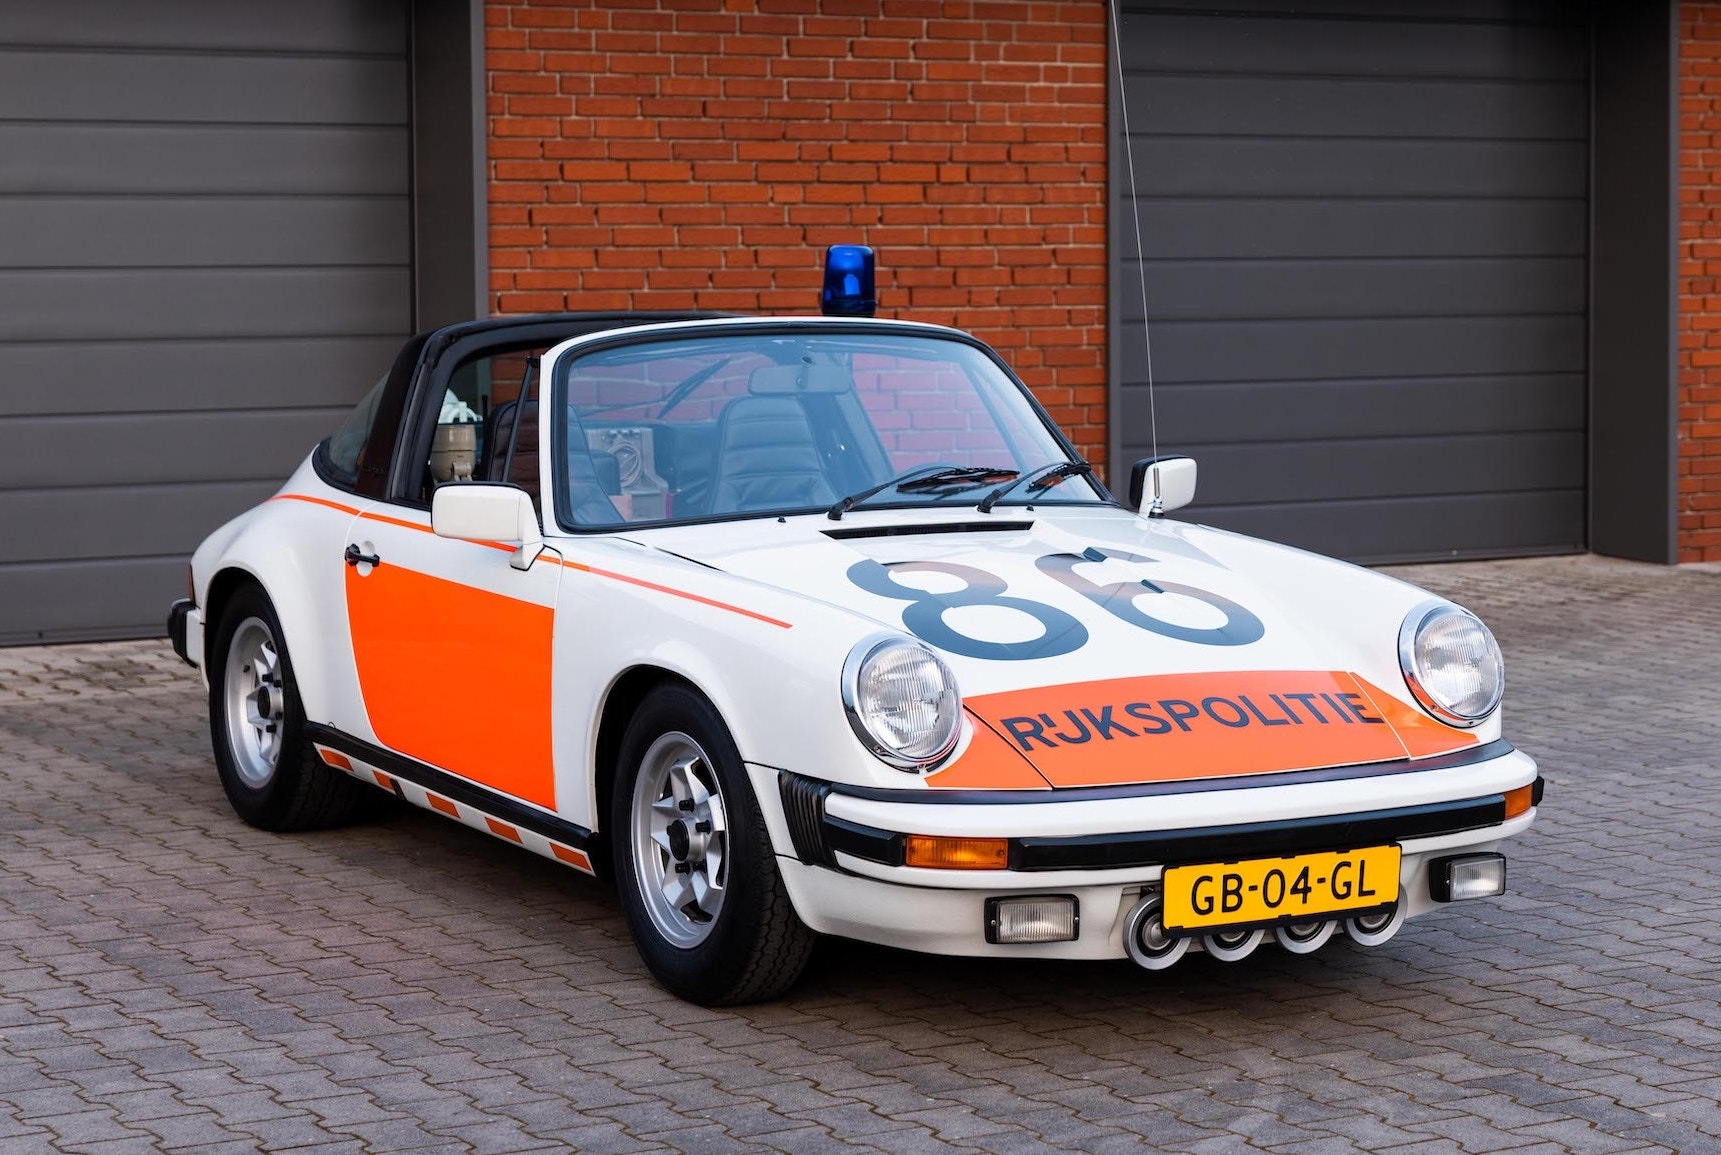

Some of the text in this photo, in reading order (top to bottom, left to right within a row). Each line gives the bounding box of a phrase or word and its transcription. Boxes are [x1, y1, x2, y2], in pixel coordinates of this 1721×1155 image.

[846, 546, 1266, 661] 86
[1000, 693, 1385, 752] RIJKSPOLITIE
[1191, 859, 1376, 916] GB-04-GL
